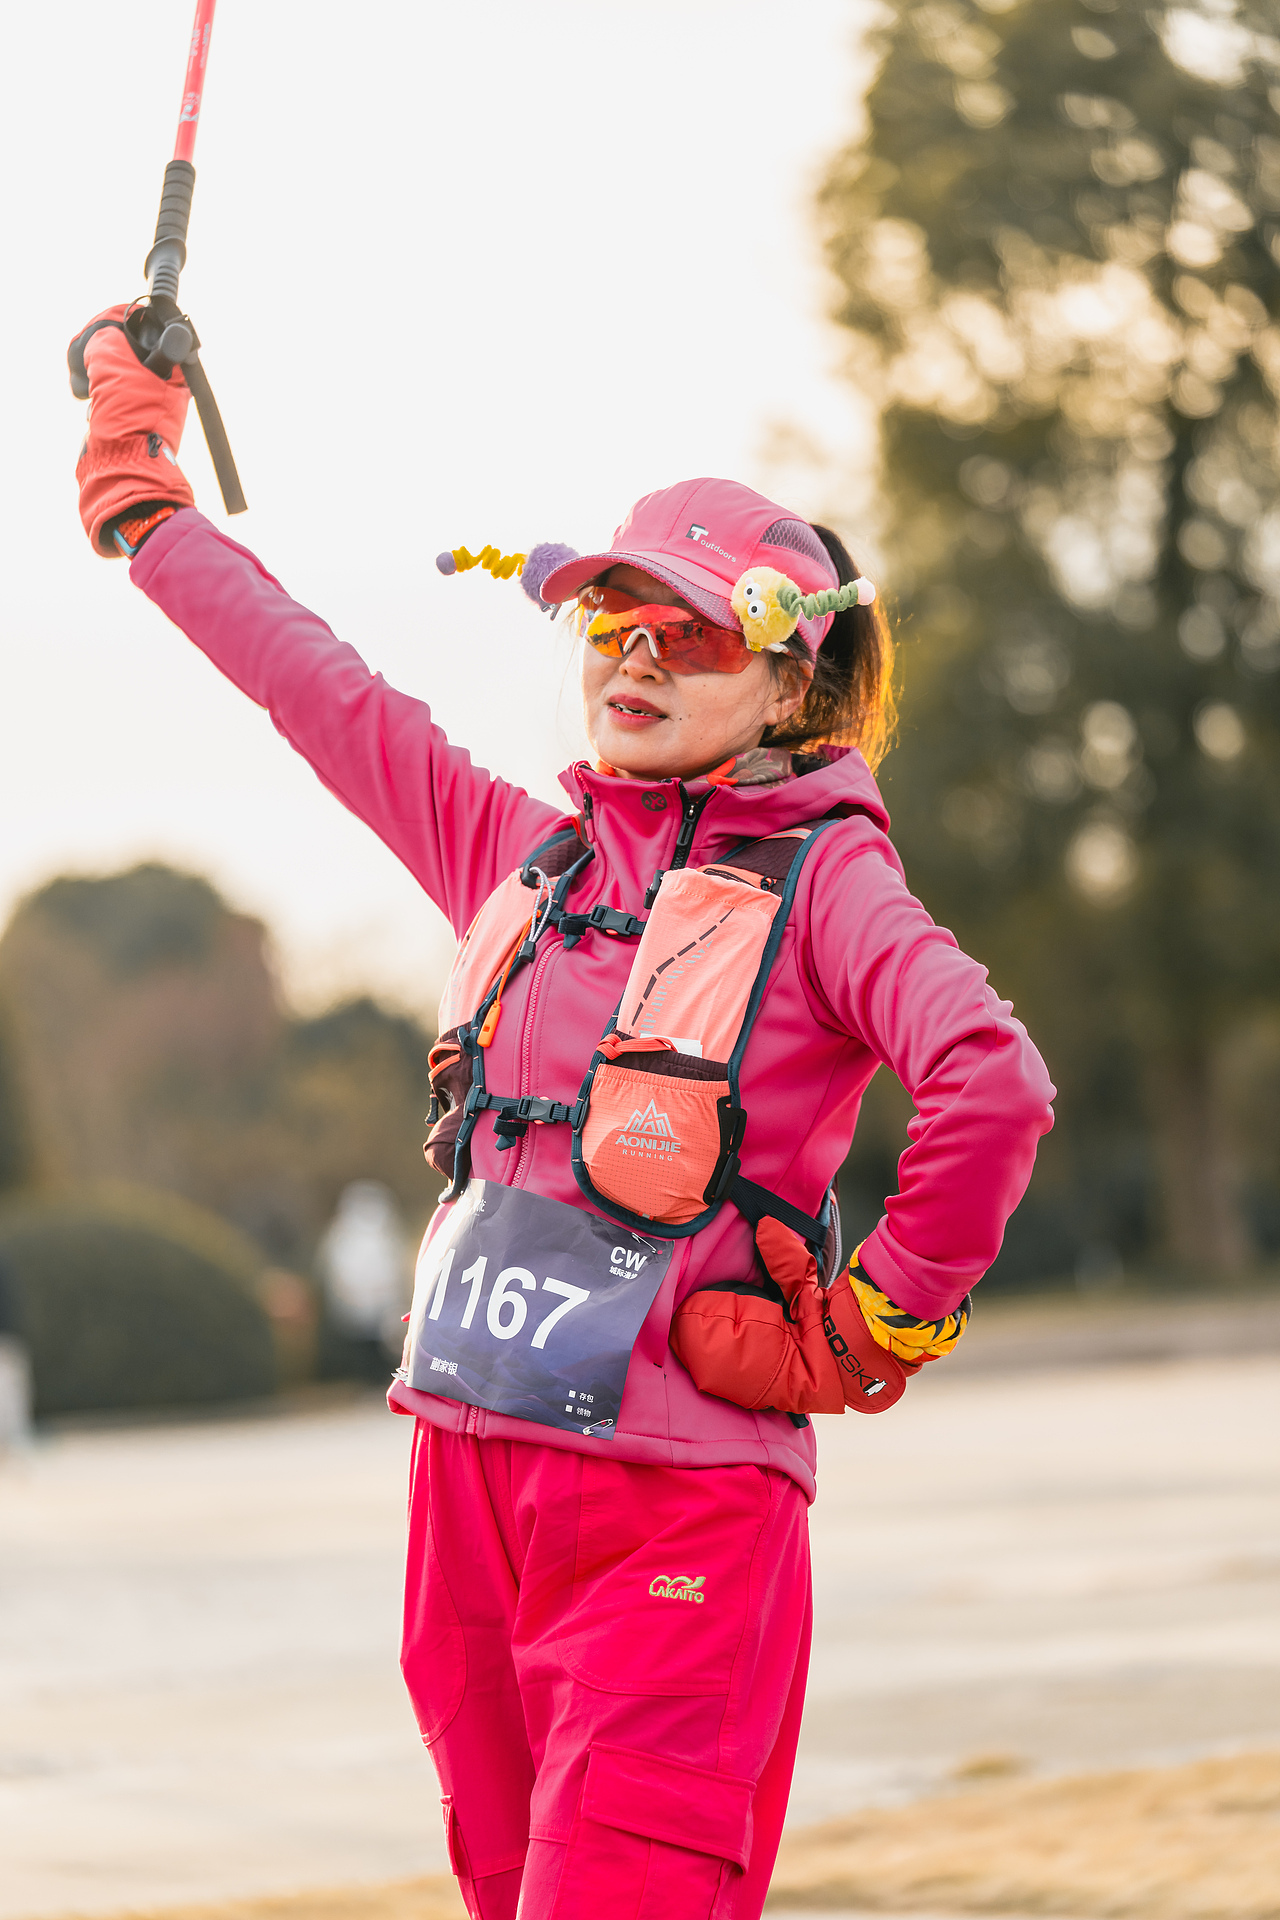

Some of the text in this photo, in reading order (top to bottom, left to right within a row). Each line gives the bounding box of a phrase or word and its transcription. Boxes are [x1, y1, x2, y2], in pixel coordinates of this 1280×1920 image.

[615, 1134, 681, 1153] AONIJIE
[622, 1148, 673, 1162] RUNNING
[610, 1246, 648, 1272] CW
[428, 1249, 591, 1350] 1167
[579, 1392, 594, 1403] 存包
[576, 1407, 591, 1418] 领物
[648, 1584, 705, 1604] LAKAITO
